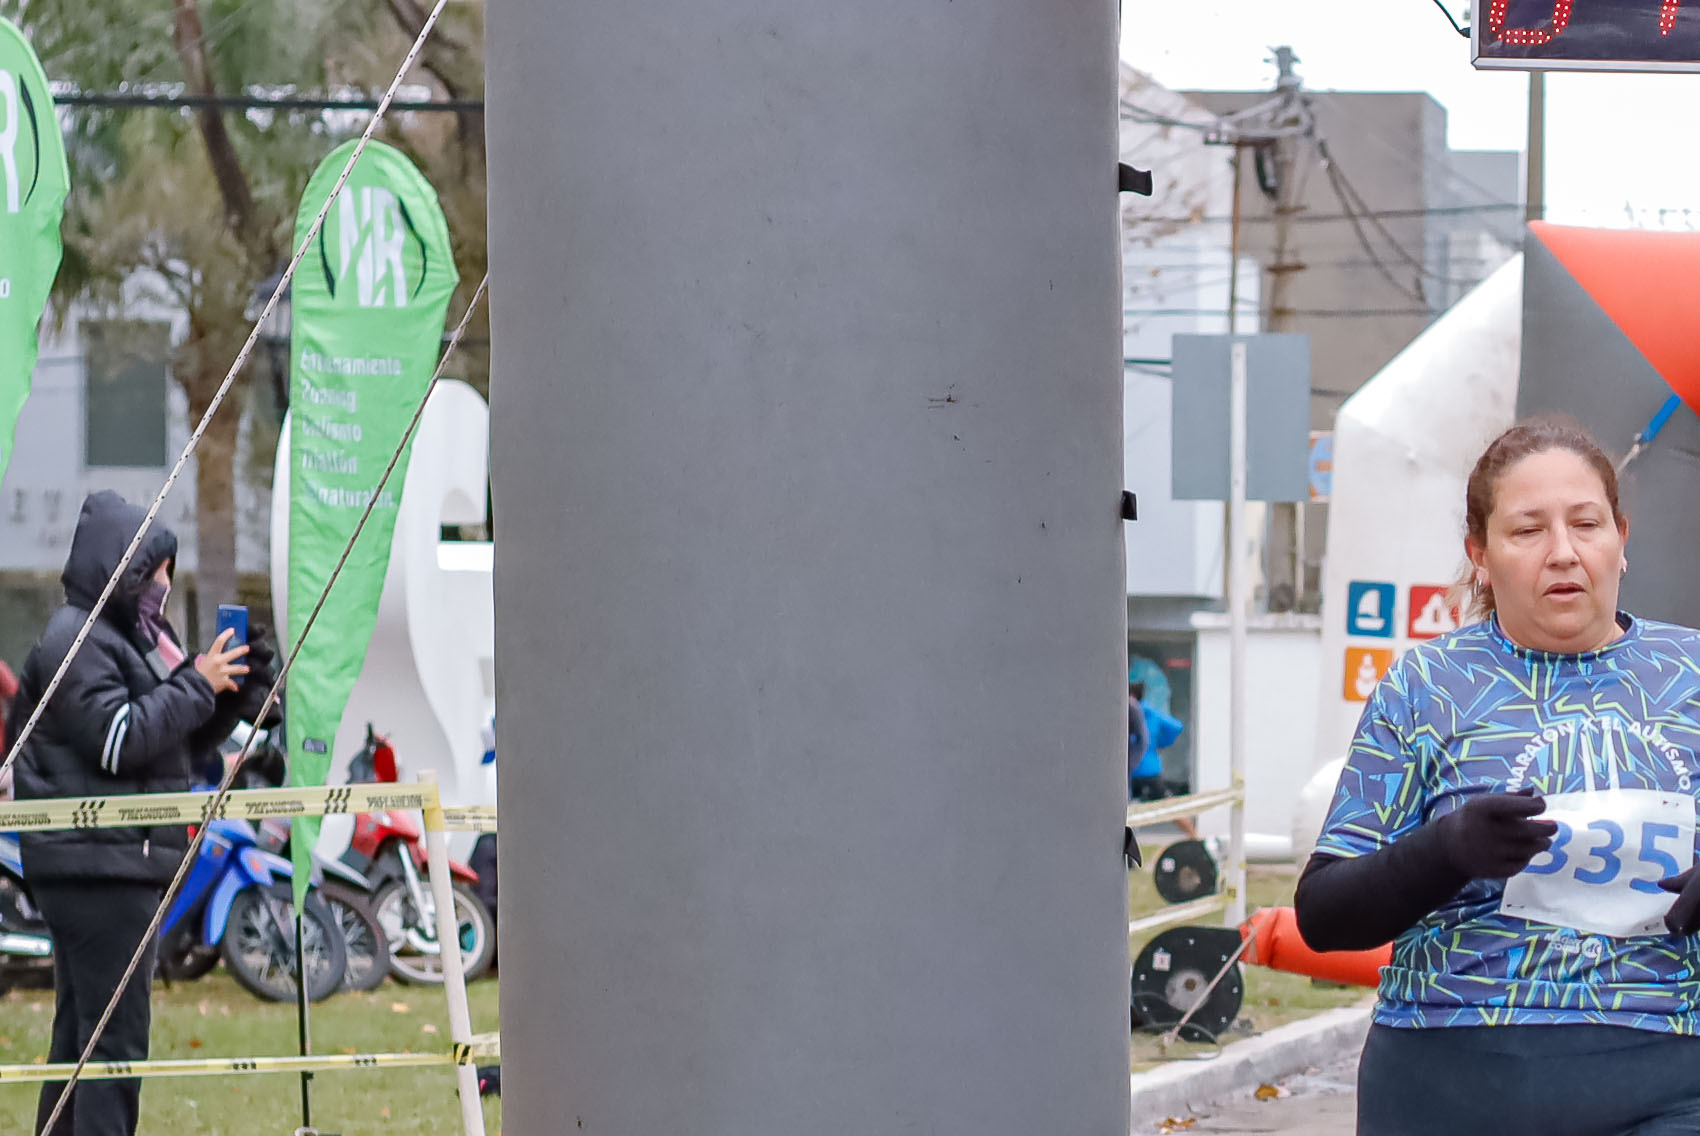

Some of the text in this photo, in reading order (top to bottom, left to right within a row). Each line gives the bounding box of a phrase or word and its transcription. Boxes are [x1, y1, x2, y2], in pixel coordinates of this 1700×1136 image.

[1506, 719, 1576, 792] MARATON
[1601, 715, 1621, 732] EL
[1628, 721, 1692, 790] AUTISMO
